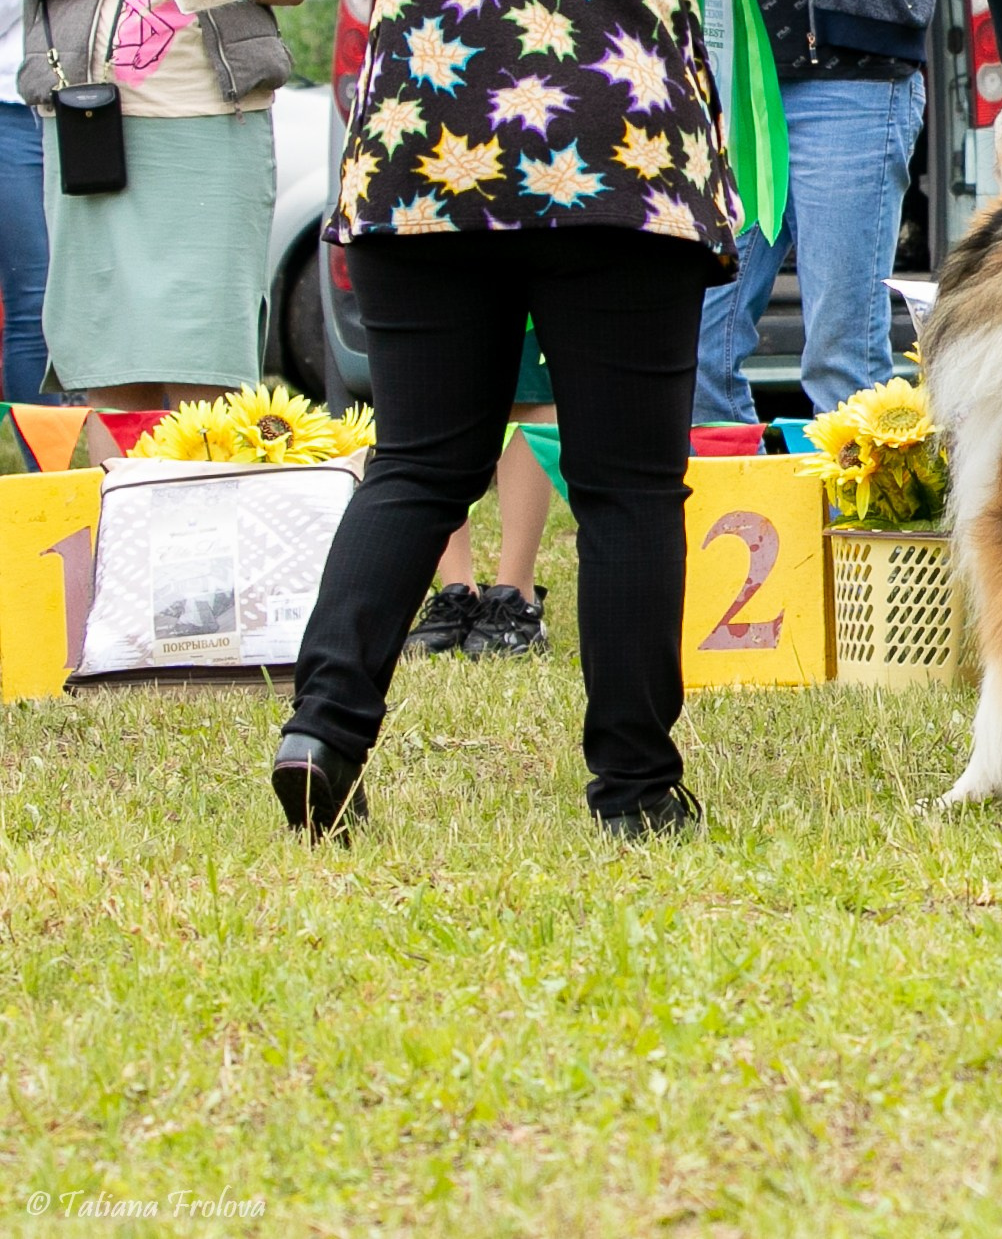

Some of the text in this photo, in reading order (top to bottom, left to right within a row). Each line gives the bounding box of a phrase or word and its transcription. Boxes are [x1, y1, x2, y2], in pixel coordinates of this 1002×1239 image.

[39, 525, 92, 669] 1
[162, 637, 231, 654] ПОКРЫВАЛО
[698, 510, 785, 651] 2
